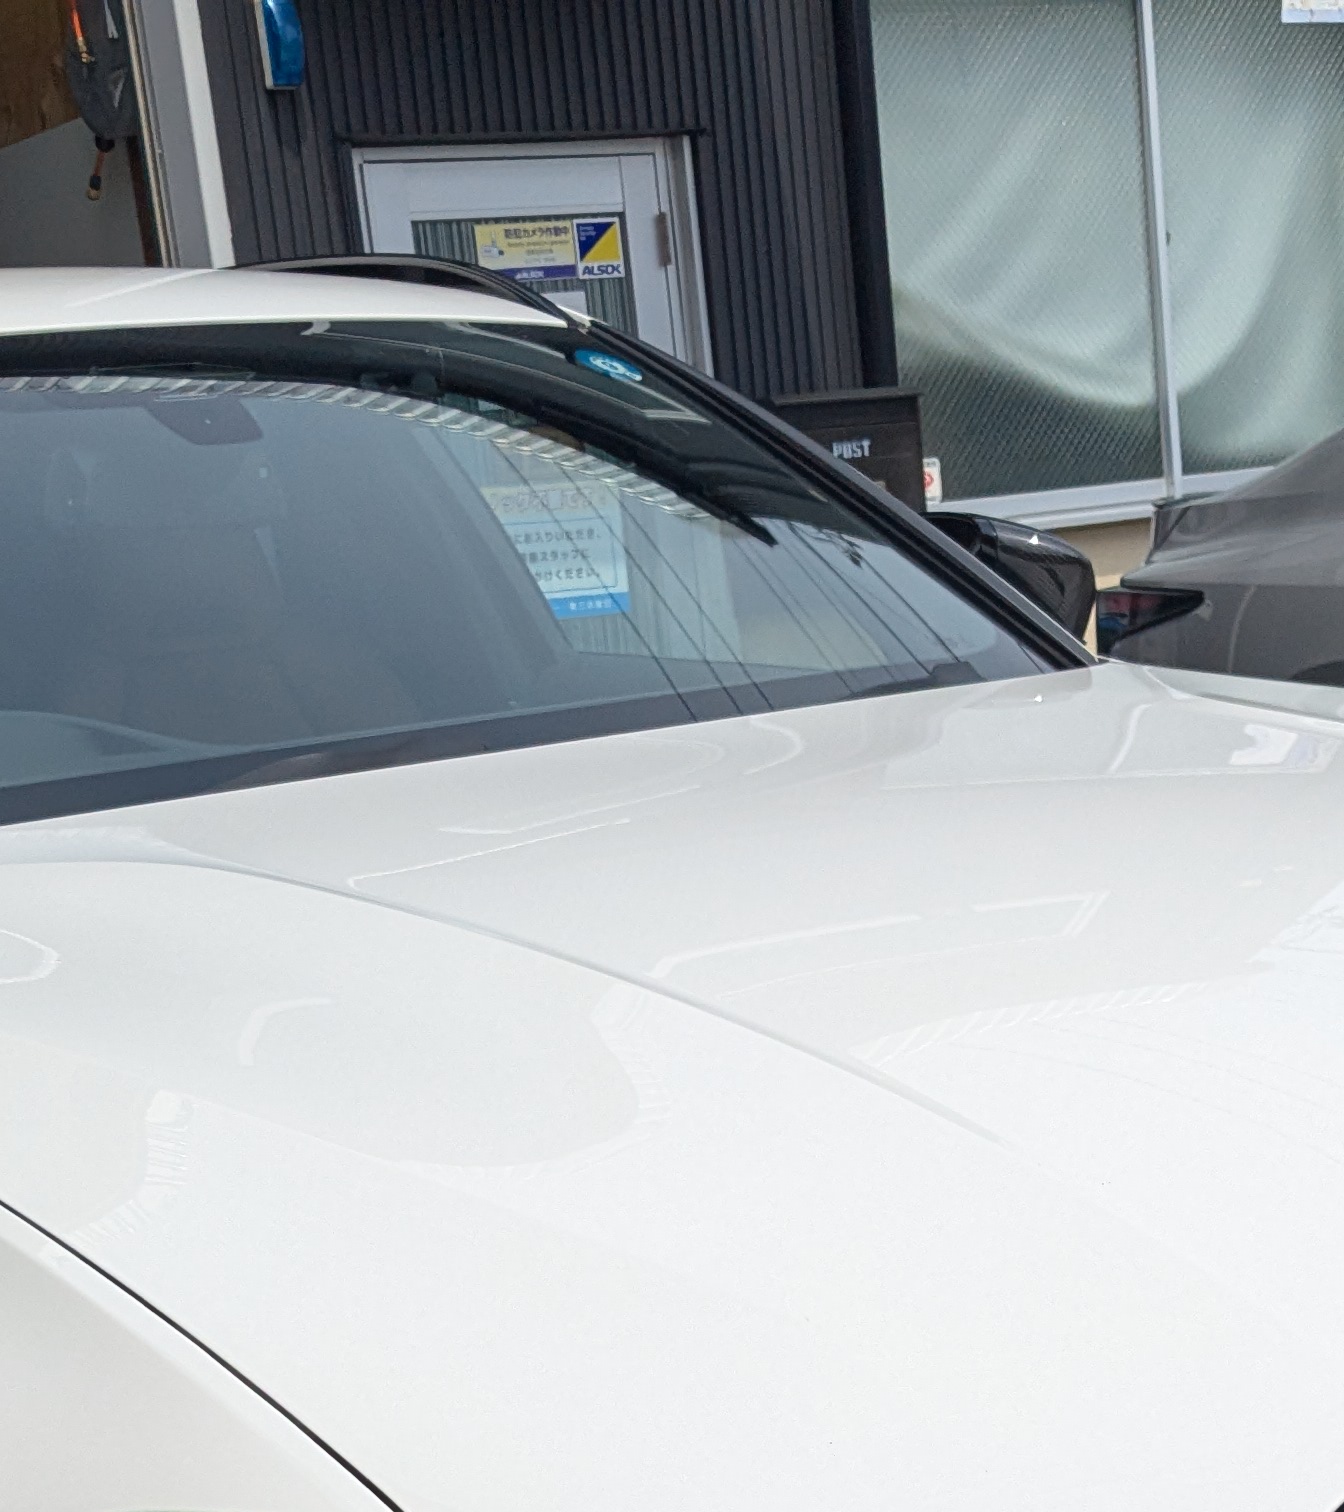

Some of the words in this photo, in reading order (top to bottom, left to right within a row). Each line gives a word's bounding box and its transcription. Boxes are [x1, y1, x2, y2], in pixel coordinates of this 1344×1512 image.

[504, 226, 570, 239] 防犯カメラ作動中
[582, 264, 622, 276] ALSOK
[832, 439, 871, 459] POST
